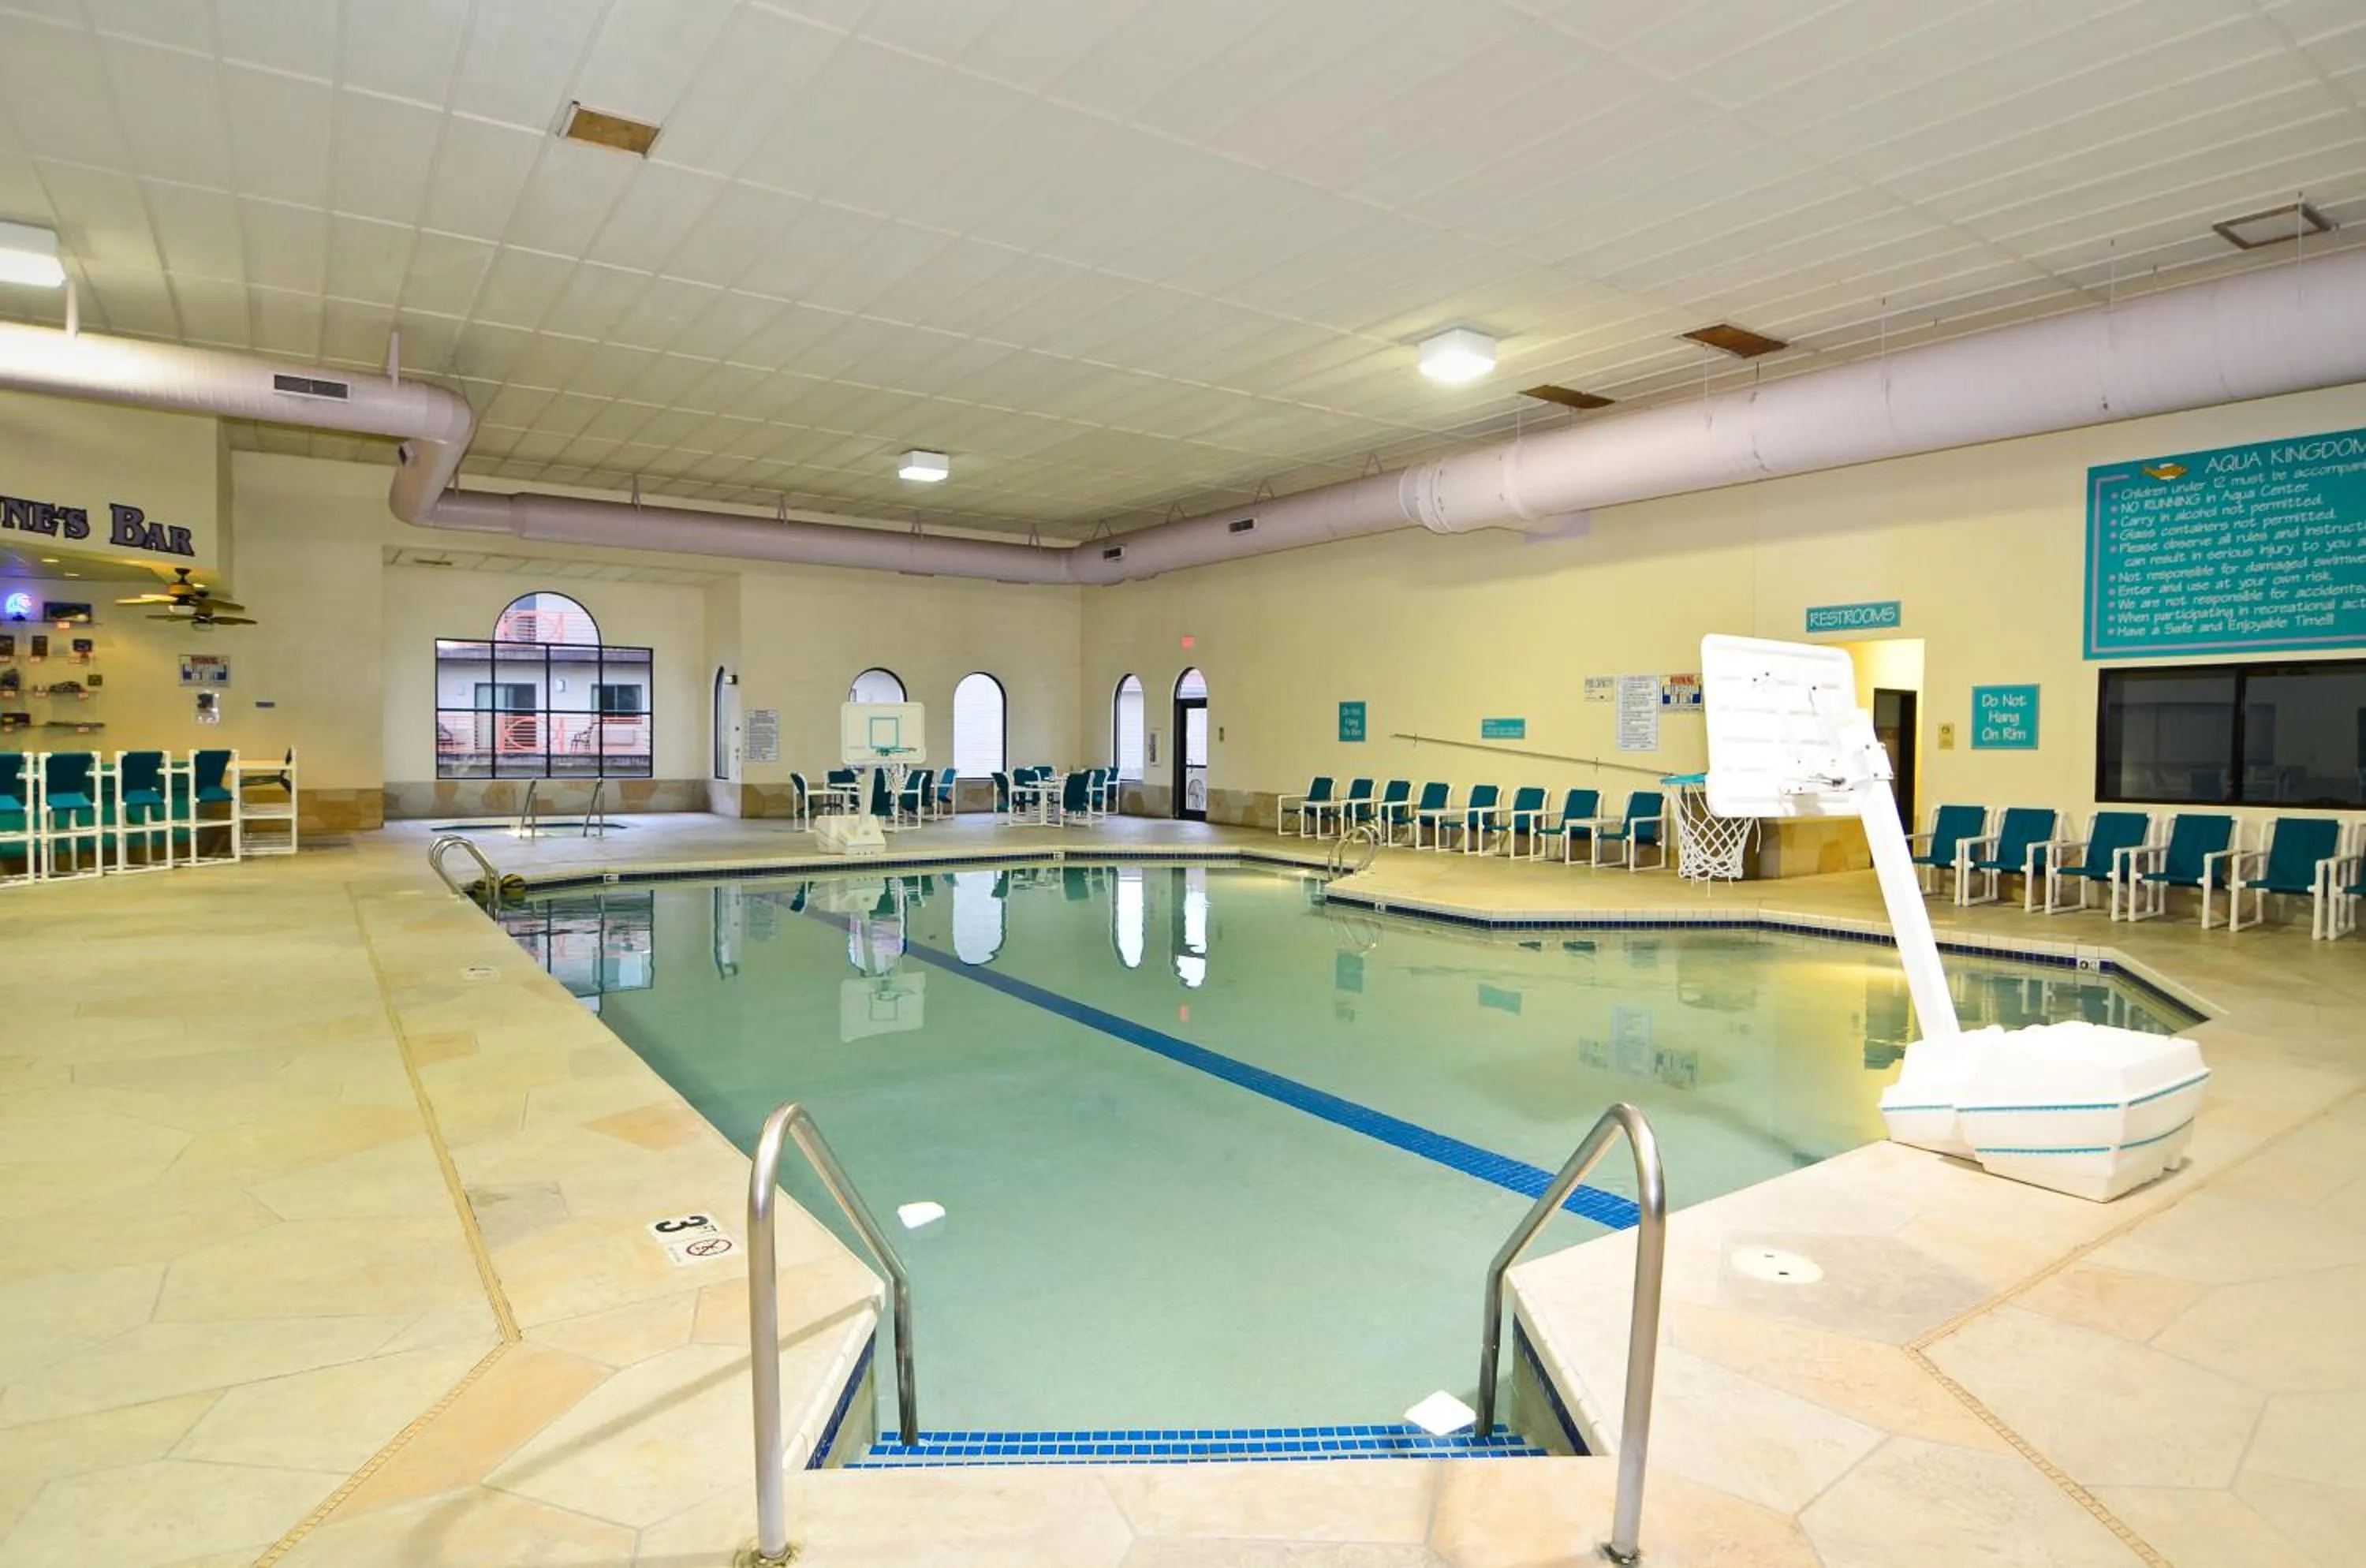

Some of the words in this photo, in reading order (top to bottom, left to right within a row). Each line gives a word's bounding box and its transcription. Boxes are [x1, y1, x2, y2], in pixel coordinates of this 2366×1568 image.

[2204, 450, 2262, 473] AQUA
[2121, 486, 2167, 500] Children
[2171, 480, 2207, 495] under
[2214, 475, 2226, 488] 12
[2231, 473, 2265, 486] must
[2272, 470, 2286, 481] be
[2121, 501, 2140, 513] NO
[2144, 493, 2200, 510] RUNNING
[2206, 494, 2216, 503] in
[2222, 488, 2256, 504] Aqua
[0, 495, 89, 539] NE'S
[2120, 515, 2155, 528] Carry
[2160, 513, 2170, 522] in
[2174, 506, 2218, 521] alcohol
[2221, 503, 2245, 515] not
[2120, 528, 2156, 540] Glass
[2161, 521, 2229, 536] containers
[2233, 517, 2256, 528] not
[2120, 542, 2159, 554] Please
[2163, 537, 2212, 550] observe
[2218, 532, 2231, 545] all
[2236, 531, 2267, 543] rules
[2274, 526, 2299, 540] and
[2124, 557, 2146, 568] can
[2150, 552, 2186, 565] result
[2192, 551, 2201, 562] in
[2207, 547, 2254, 560] serious
[2260, 542, 2294, 558] injury
[2302, 540, 2319, 551] to
[2325, 538, 2352, 552] you
[2118, 572, 2142, 583] Not
[2147, 565, 2215, 582] responsible
[2221, 563, 2239, 574] for
[2245, 556, 2308, 573] damaged
[2118, 584, 2153, 596] Enter
[2159, 581, 2182, 593] and
[2187, 581, 2209, 592] use
[2215, 578, 2231, 590] at
[2237, 577, 2267, 591] your
[2272, 574, 2300, 585] own
[2117, 598, 2136, 610] We
[2140, 598, 2160, 609] are
[2165, 595, 2187, 607] not
[2193, 589, 2263, 607] responsible
[2270, 588, 2289, 599] for
[1809, 606, 1896, 627] RESTROOMS
[2118, 611, 2149, 624] When
[2154, 607, 2234, 624] participating
[2238, 606, 2248, 616] in
[2253, 598, 2335, 615] recreational
[2117, 625, 2146, 637] Have
[2151, 626, 2159, 636] a
[2163, 622, 2193, 635] Safe
[2199, 620, 2222, 632] and
[2227, 617, 2289, 633] Enjoyable
[1982, 694, 1998, 707] Do
[2002, 694, 2027, 707] Not
[1988, 711, 2020, 726] Hang
[1982, 727, 1999, 741] On
[2002, 727, 2026, 741] Rim
[655, 1215, 709, 1233] 3
